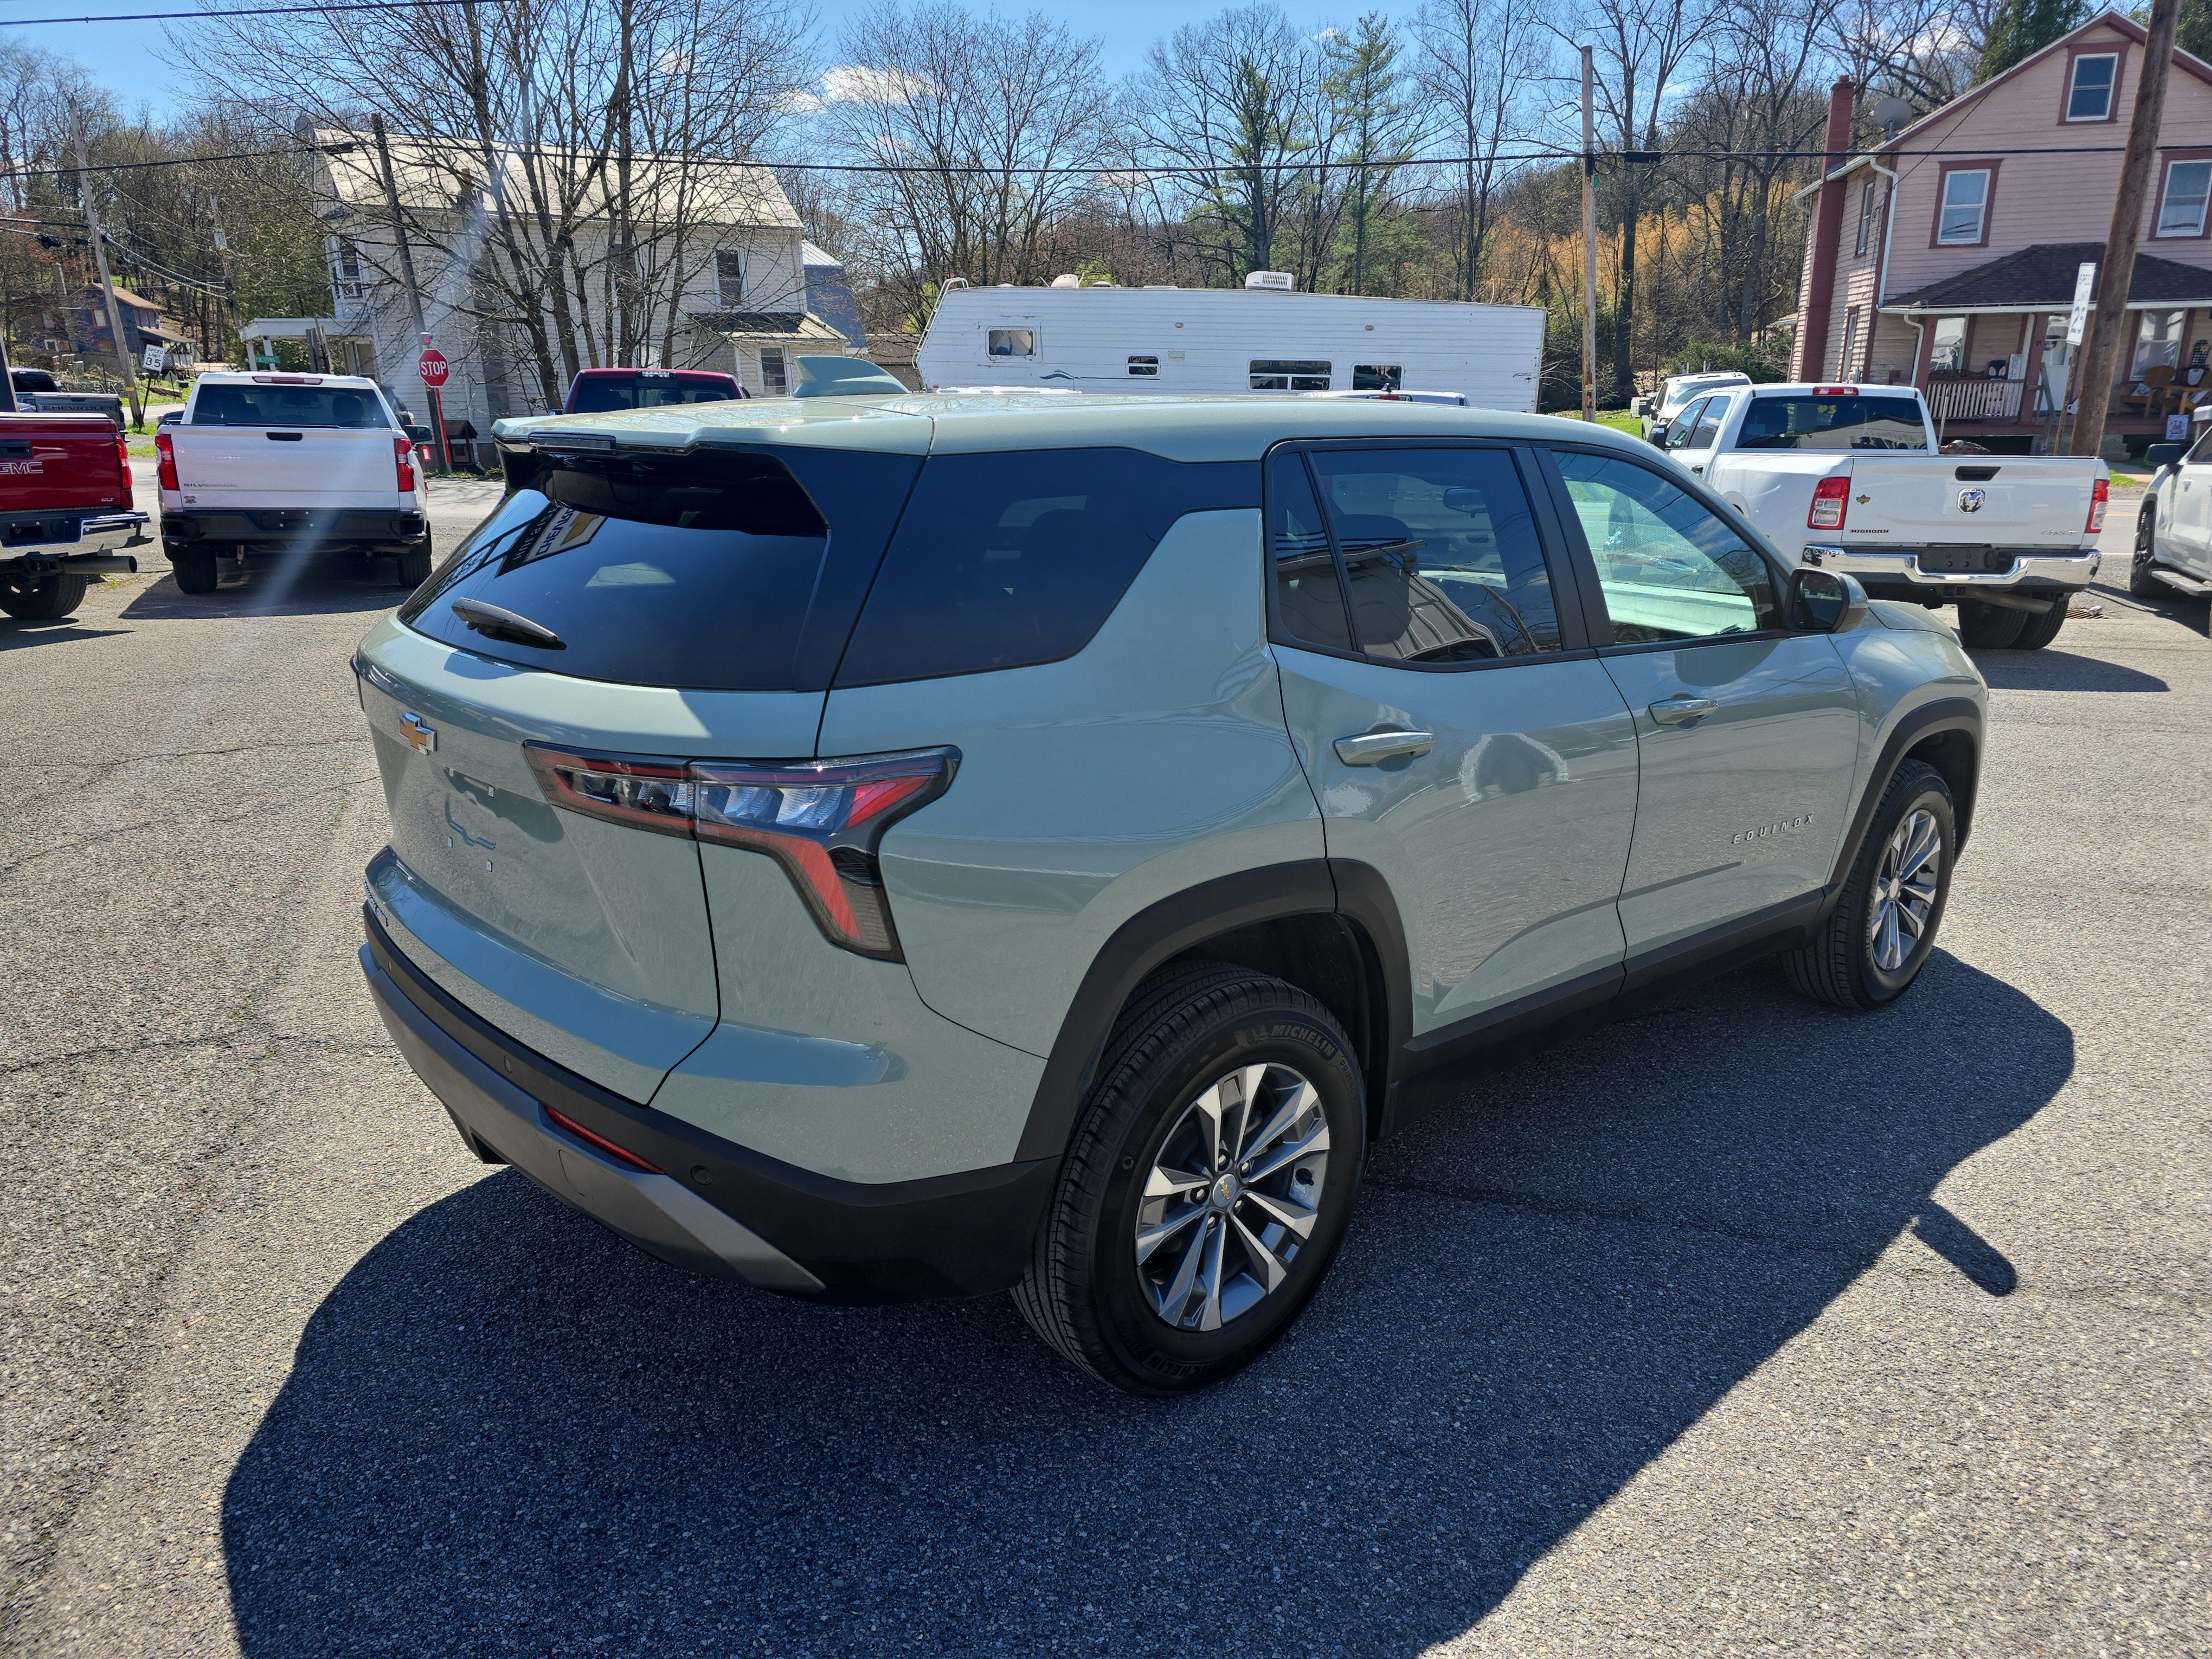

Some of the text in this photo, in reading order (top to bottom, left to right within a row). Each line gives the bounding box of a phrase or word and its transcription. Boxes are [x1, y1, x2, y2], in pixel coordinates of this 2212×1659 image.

[145, 357, 162, 368] 35
[421, 361, 446, 376] STOP
[0, 461, 43, 475] GMC
[1732, 813, 1814, 844] EQUINOX
[1271, 1024, 1335, 1056] MICHELIN
